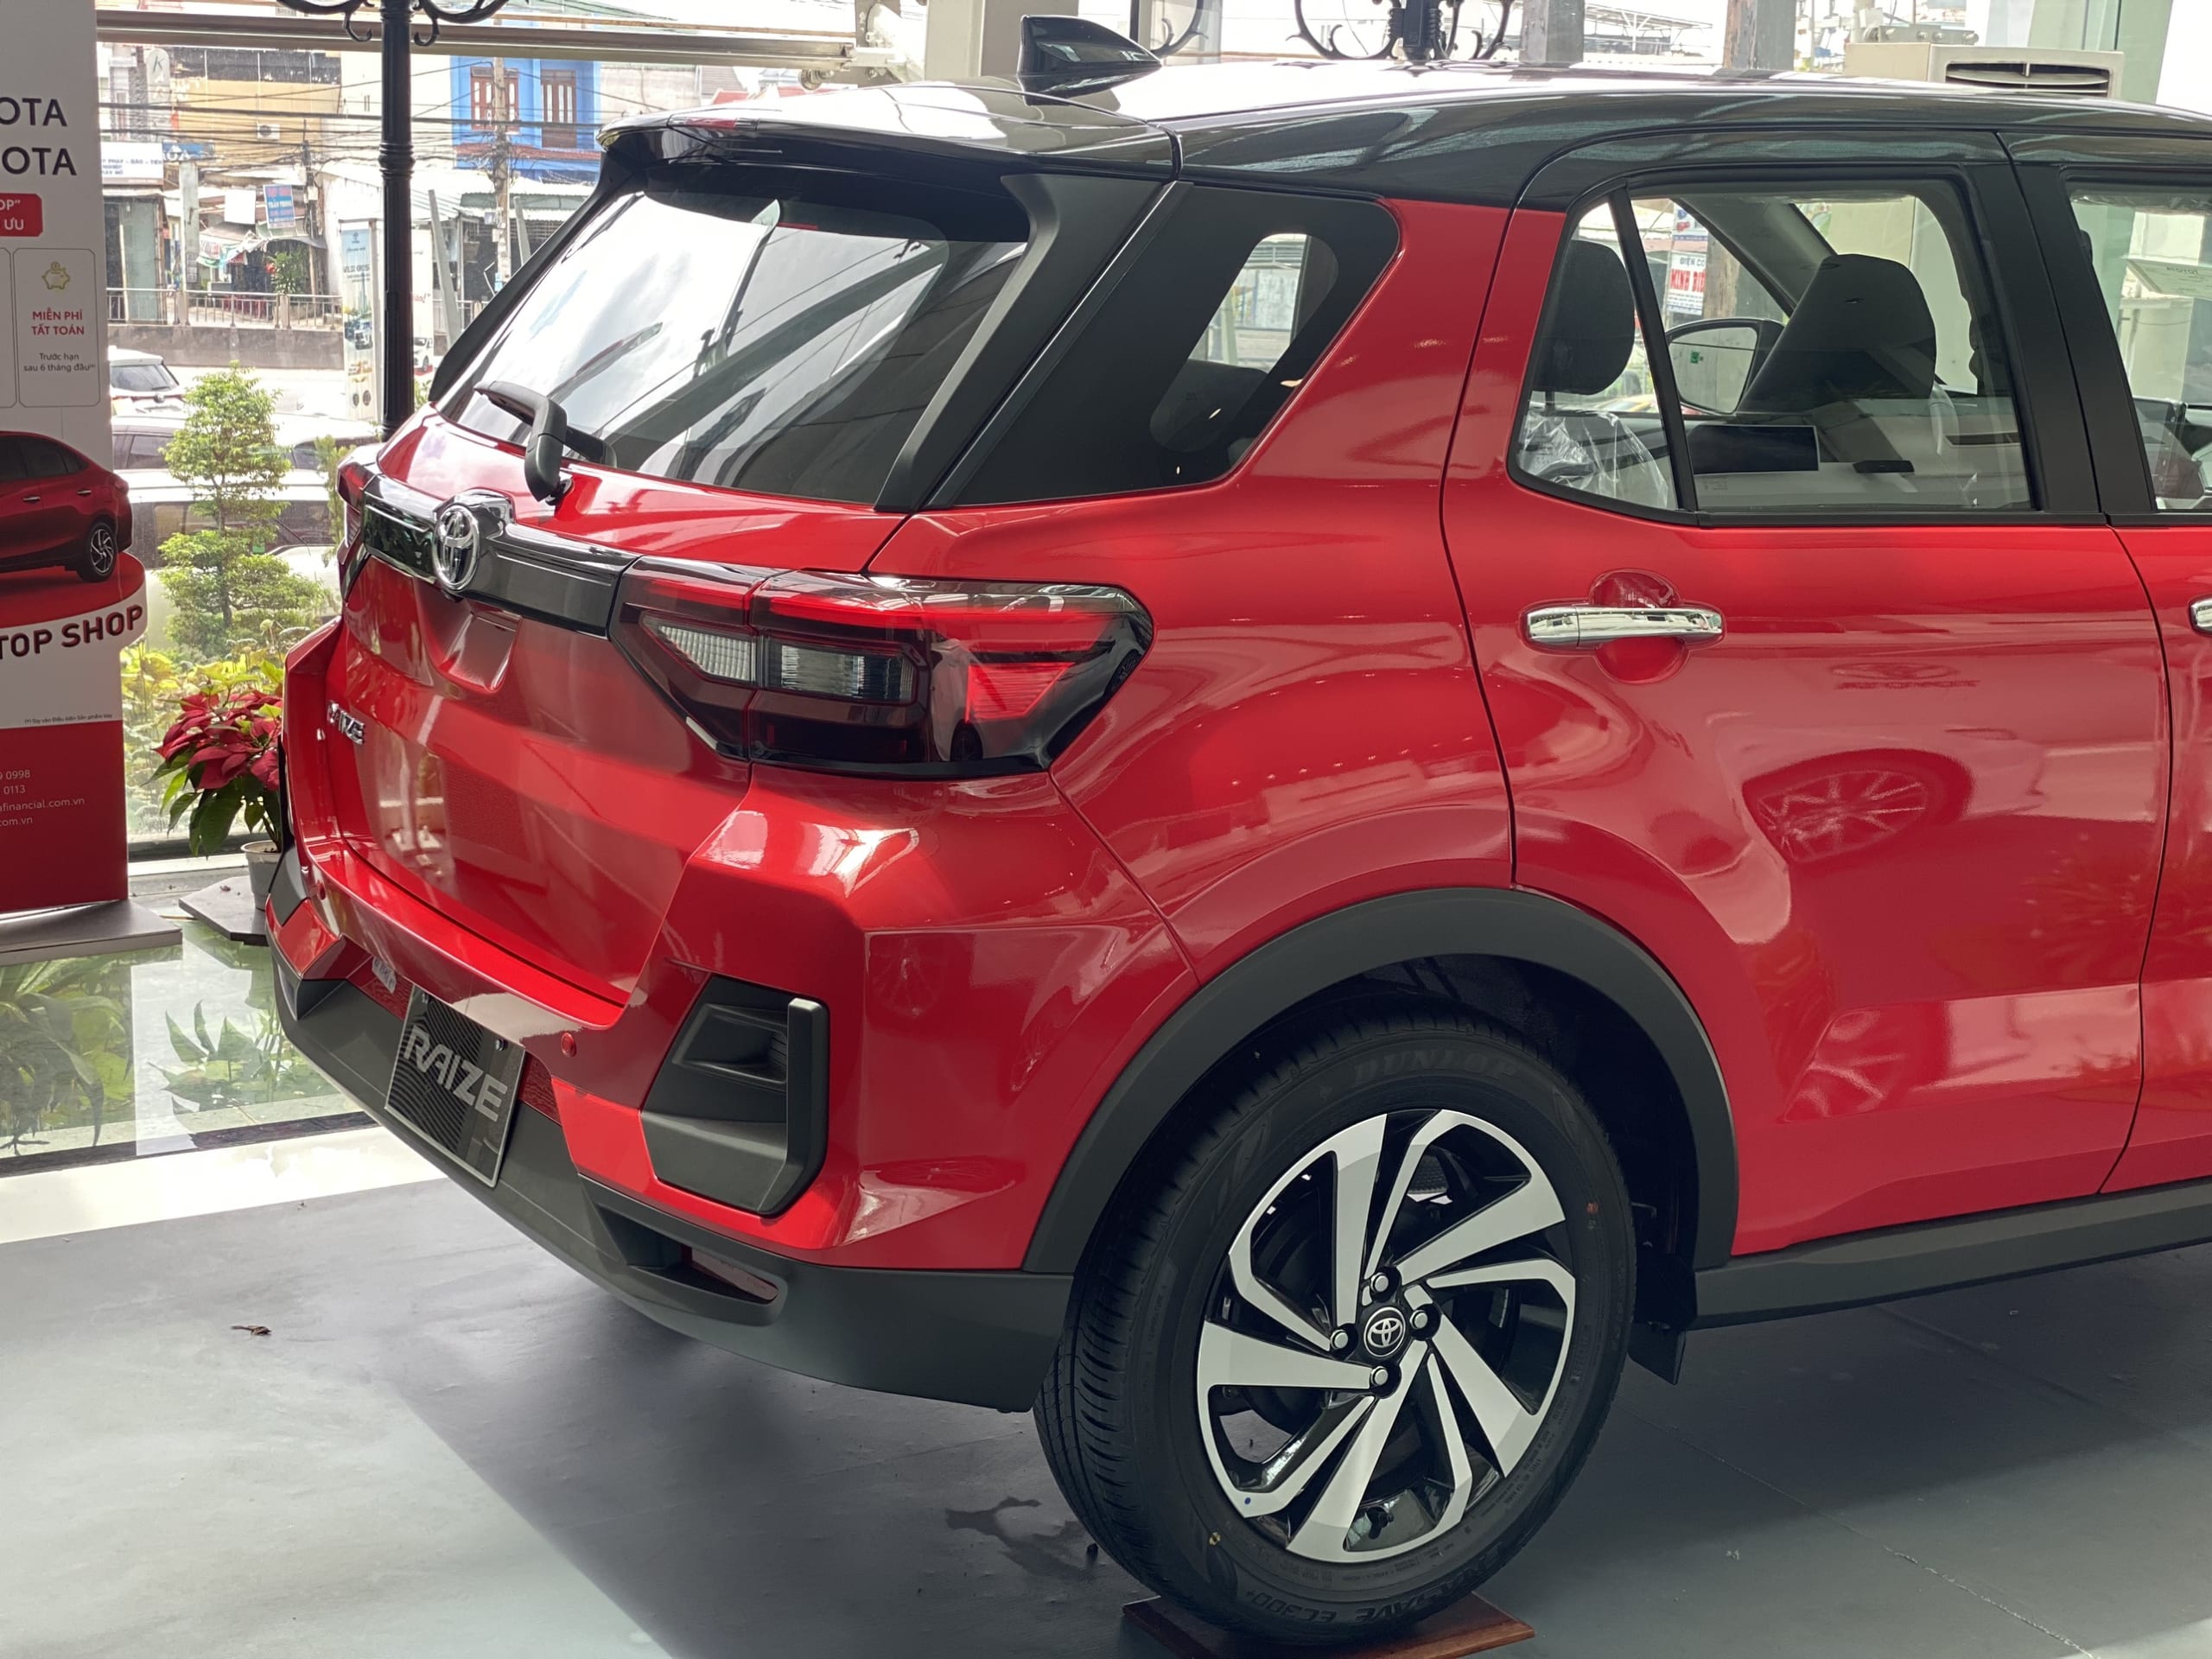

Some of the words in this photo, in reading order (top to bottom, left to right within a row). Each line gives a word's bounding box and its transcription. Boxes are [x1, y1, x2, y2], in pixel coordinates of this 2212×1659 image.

[0, 97, 67, 127] OTA
[2, 146, 78, 175] OTA
[32, 307, 61, 321] MIỄN
[64, 308, 83, 321] PHÍ
[53, 323, 85, 335] TOÁN
[63, 352, 79, 361] hạn
[48, 363, 72, 372] tháng
[61, 604, 143, 647] SHOP
[5, 769, 31, 780] 0998
[3, 784, 26, 795] 0113
[404, 1024, 508, 1122] RAIZE
